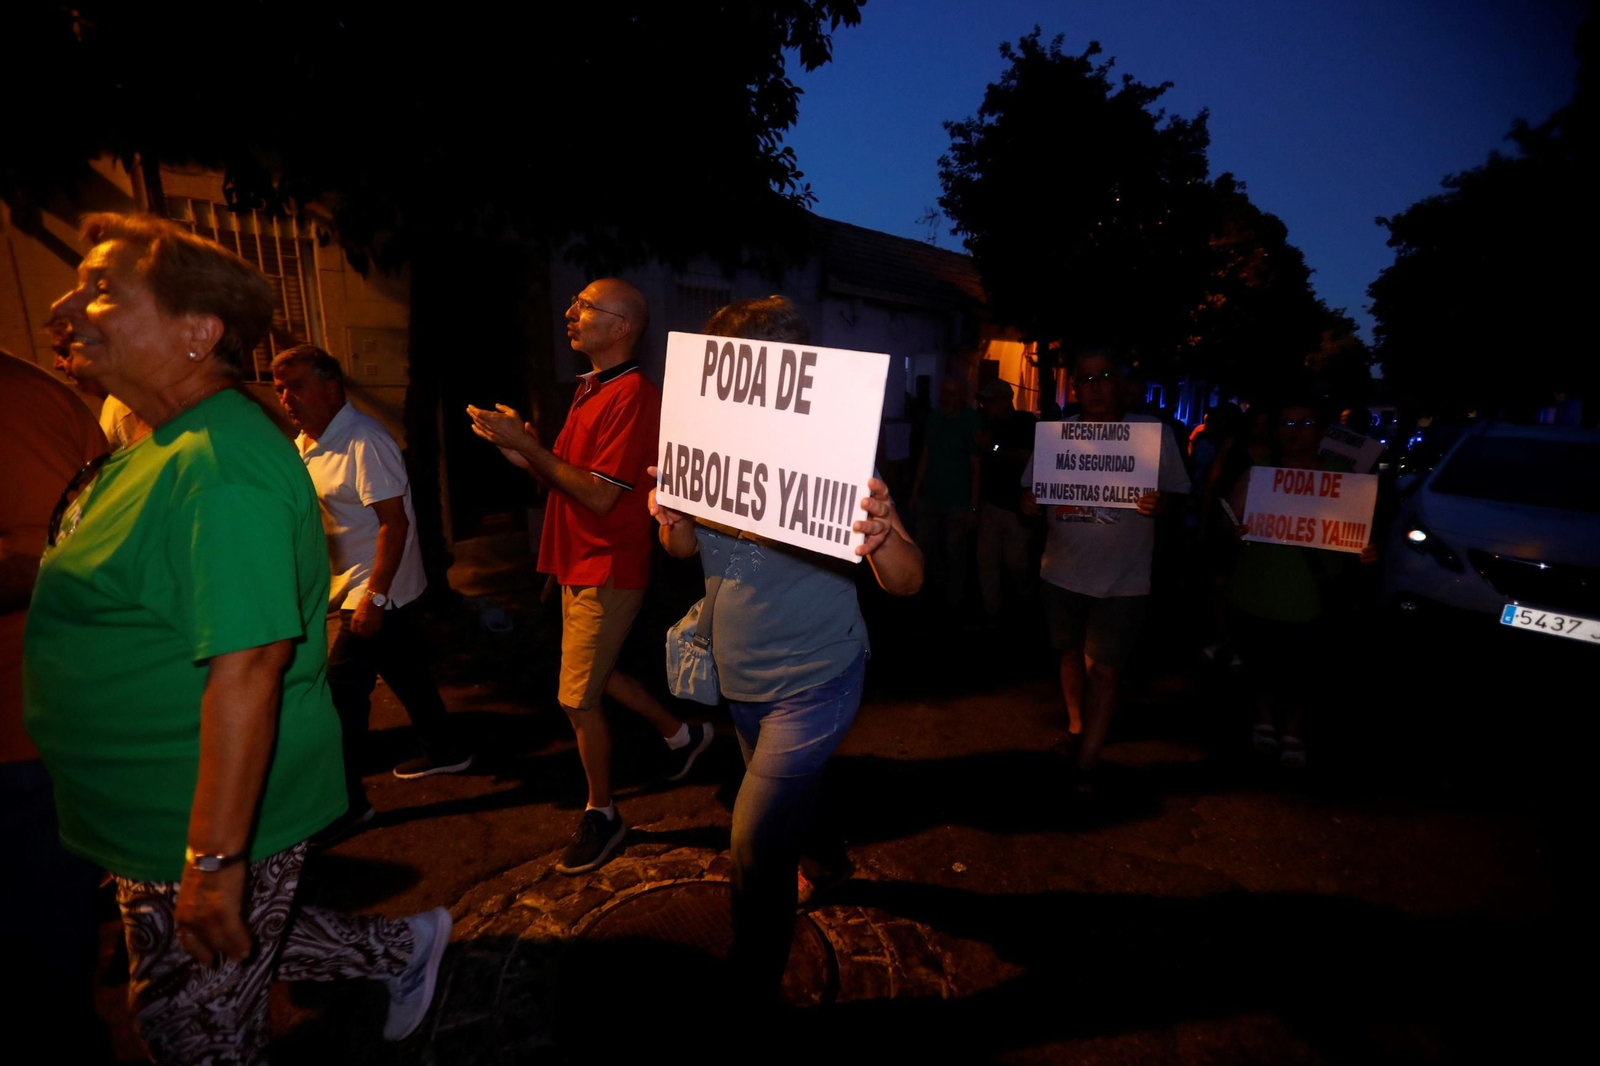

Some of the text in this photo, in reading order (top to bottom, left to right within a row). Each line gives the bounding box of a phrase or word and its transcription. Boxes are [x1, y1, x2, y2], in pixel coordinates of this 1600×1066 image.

[700, 339, 818, 415] PODA DE
[1061, 423, 1130, 441] NECESITAMOS
[1056, 450, 1135, 472] MÁS SEGURIDAD
[660, 441, 858, 546] ARBOLES YA!!!!!
[1035, 482, 1047, 499] EN
[1050, 483, 1100, 502] NUESTRAS
[1102, 485, 1140, 503] CALLES
[1273, 468, 1343, 498] PODA DE
[1246, 512, 1366, 549] ARBOLES YA!!!!!
[1520, 609, 1583, 634] 5437
